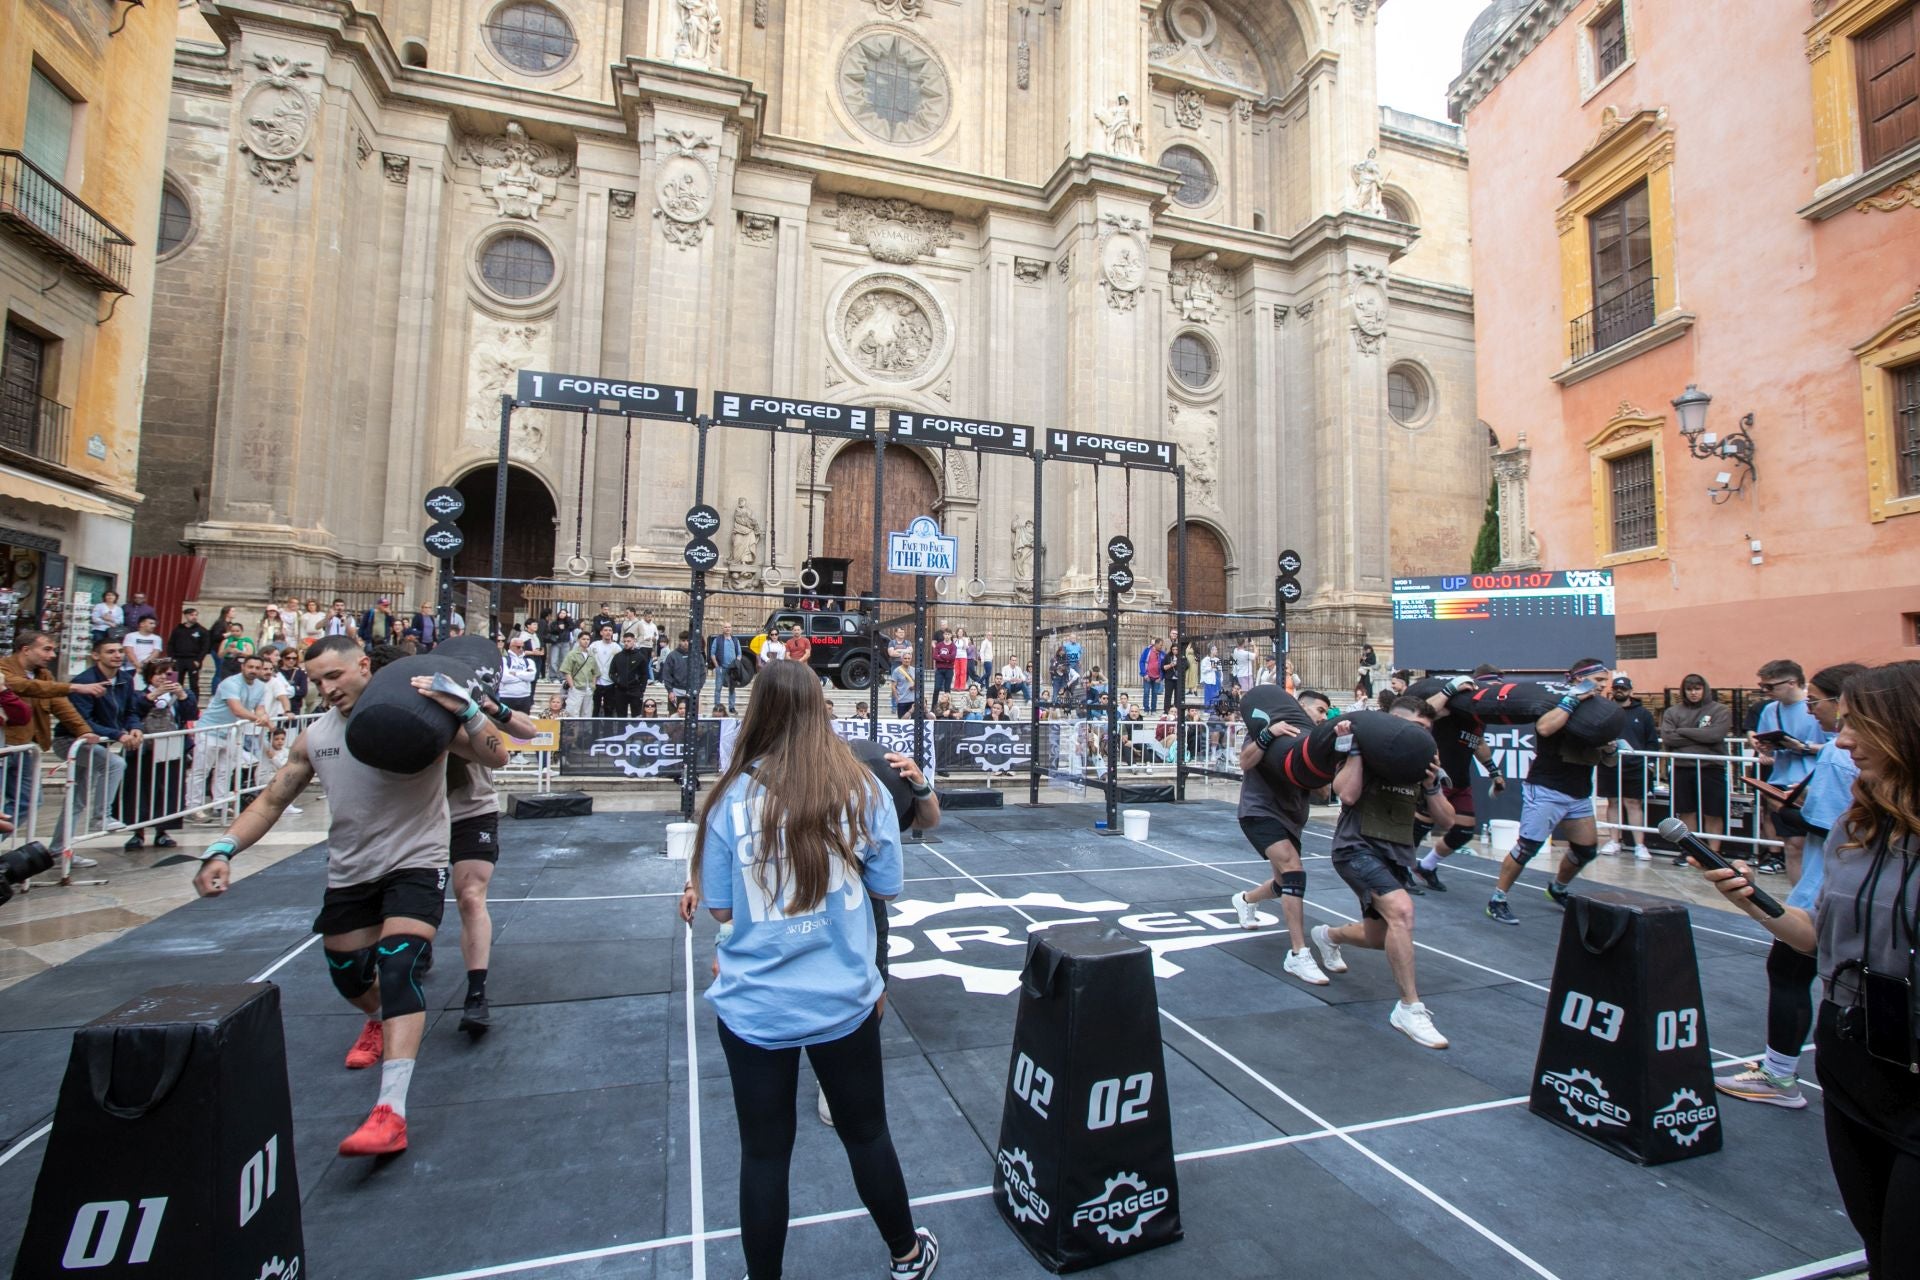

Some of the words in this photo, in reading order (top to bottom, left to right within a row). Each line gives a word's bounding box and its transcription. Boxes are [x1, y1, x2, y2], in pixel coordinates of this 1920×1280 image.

[533, 375, 543, 398] 1
[559, 378, 660, 401] FORGED
[674, 390, 684, 412] 1
[723, 395, 740, 417] 2
[750, 399, 841, 420] FORGED
[850, 409, 866, 430] 2
[897, 414, 913, 436] 3
[922, 417, 1004, 438] FORGED
[1012, 428, 1027, 447] 3
[1054, 432, 1068, 452] 4
[1076, 435, 1150, 454] FORGED
[1157, 444, 1170, 463] 4
[895, 550, 922, 567] THE
[927, 552, 950, 569] BOX
[1442, 577, 1467, 590] UP
[1472, 573, 1553, 590] 00:01:07
[1567, 575, 1612, 587] WIN
[811, 636, 827, 644] Red
[827, 636, 843, 645] Bull
[1482, 728, 1535, 748] ark
[1560, 990, 1625, 1042] 03
[1656, 1008, 1698, 1051] 03
[1013, 1051, 1054, 1120] 02
[1087, 1071, 1154, 1131] 02
[1541, 1074, 1631, 1122] FORGED
[1653, 1105, 1717, 1130] FORGED
[239, 1134, 278, 1228] 01
[997, 1151, 1050, 1220] FORGED
[1073, 1187, 1169, 1228] FORGED
[62, 1196, 169, 1269] 01
